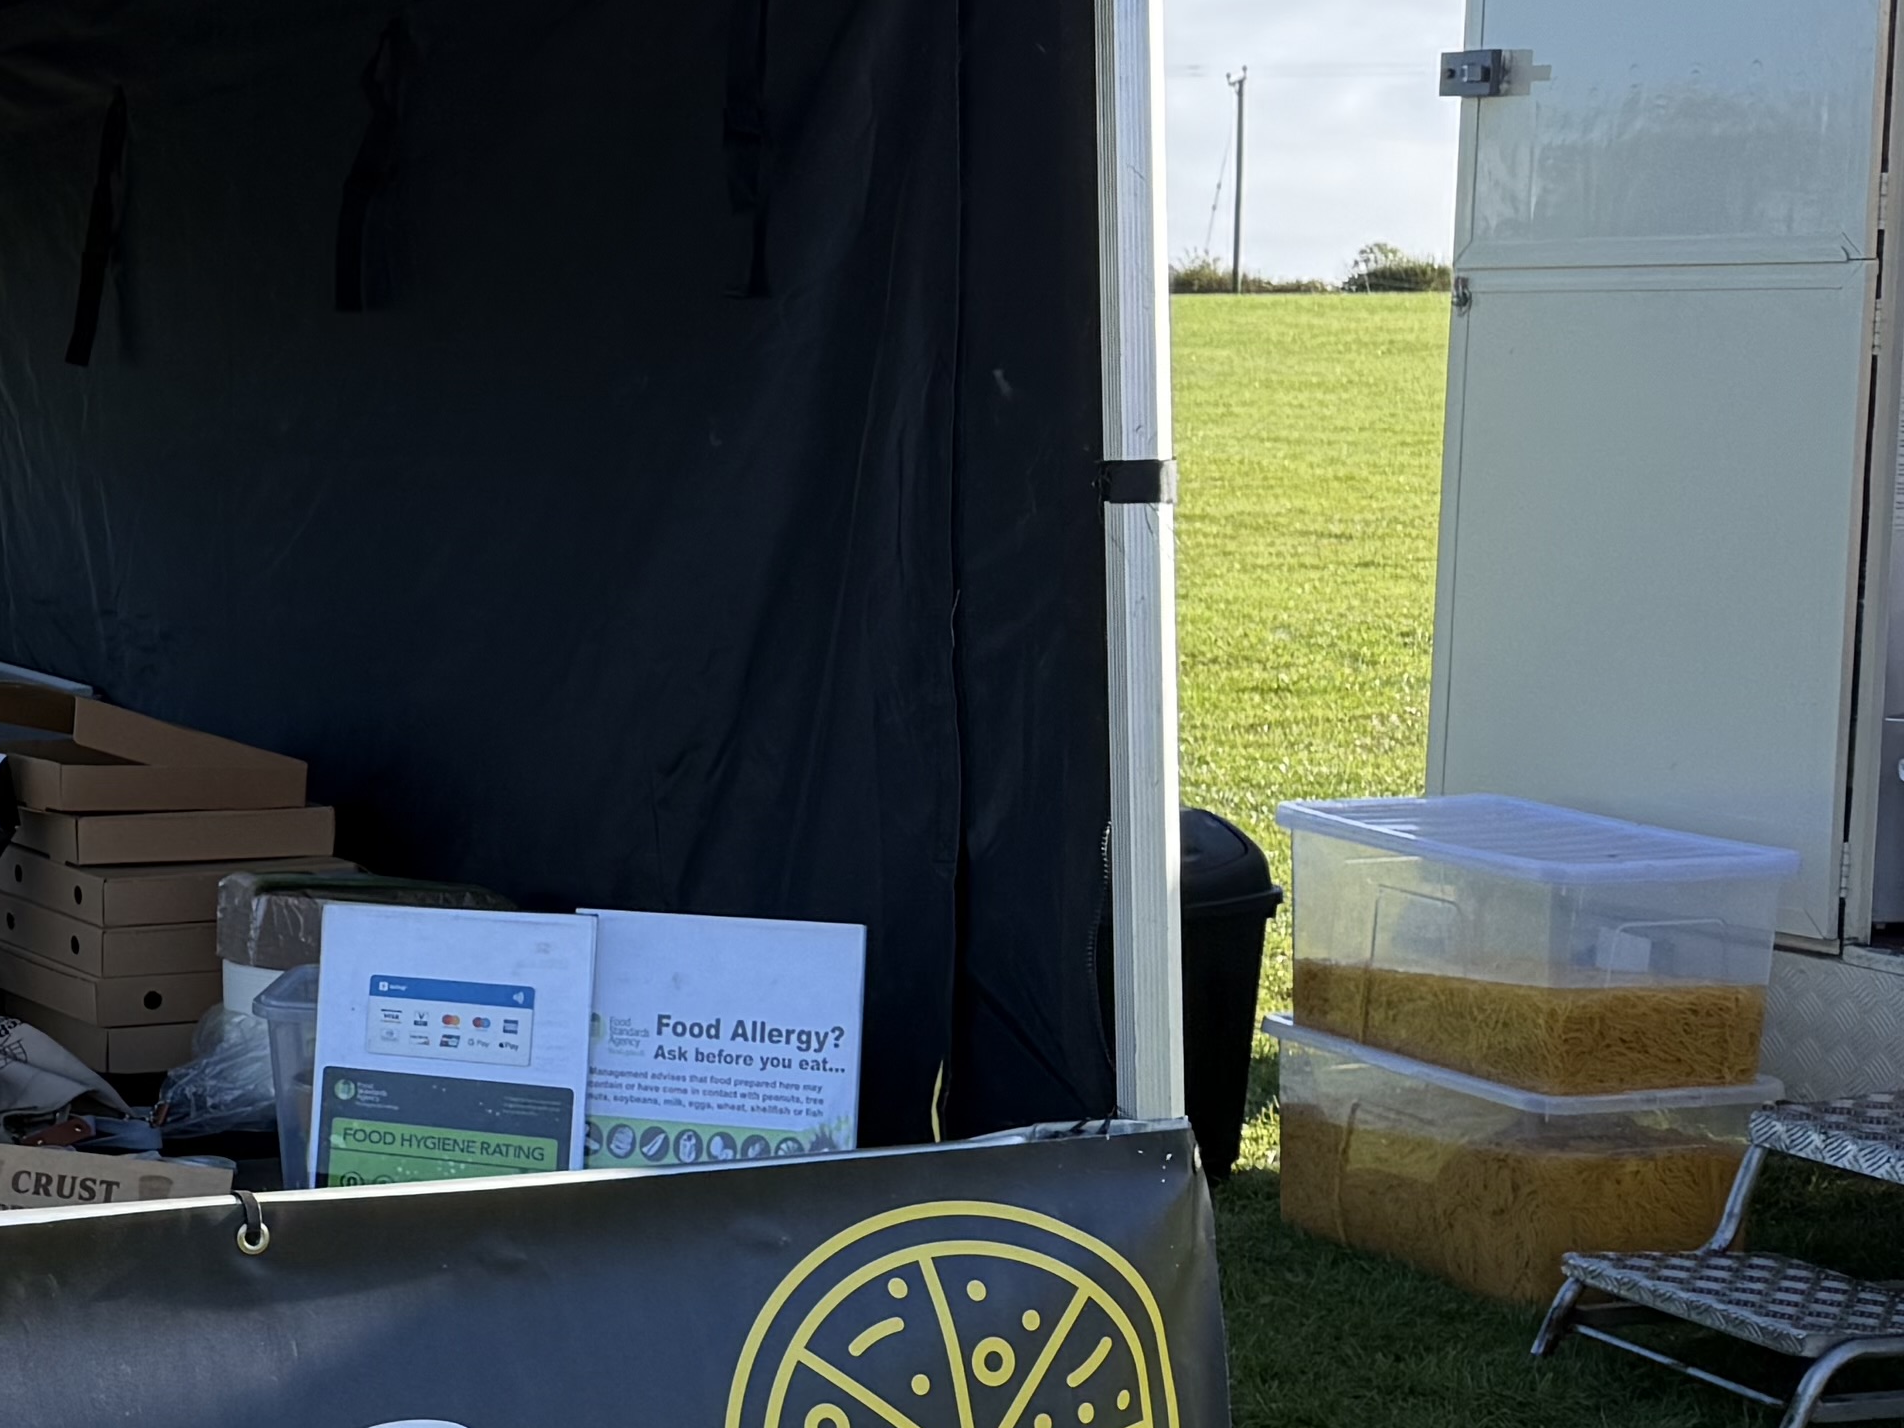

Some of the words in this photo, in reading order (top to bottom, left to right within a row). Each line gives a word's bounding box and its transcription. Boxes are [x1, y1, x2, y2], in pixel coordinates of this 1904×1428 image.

[609, 1017, 631, 1027] Food
[657, 1014, 721, 1040] Food
[730, 1020, 845, 1053] Allergy?
[654, 1044, 688, 1062] Ask
[694, 1048, 753, 1068] before
[759, 1054, 792, 1071] you
[799, 1057, 845, 1073] eat...
[650, 1071, 686, 1083] advises
[689, 1073, 707, 1084] that
[709, 1074, 731, 1086] food
[733, 1076, 776, 1091] prepared
[779, 1080, 800, 1091] here
[803, 1083, 822, 1094] may
[343, 1127, 396, 1145] FOOD
[400, 1133, 476, 1155] HYGIENE
[480, 1143, 545, 1162] RATING
[11, 1170, 120, 1204] CRUST
